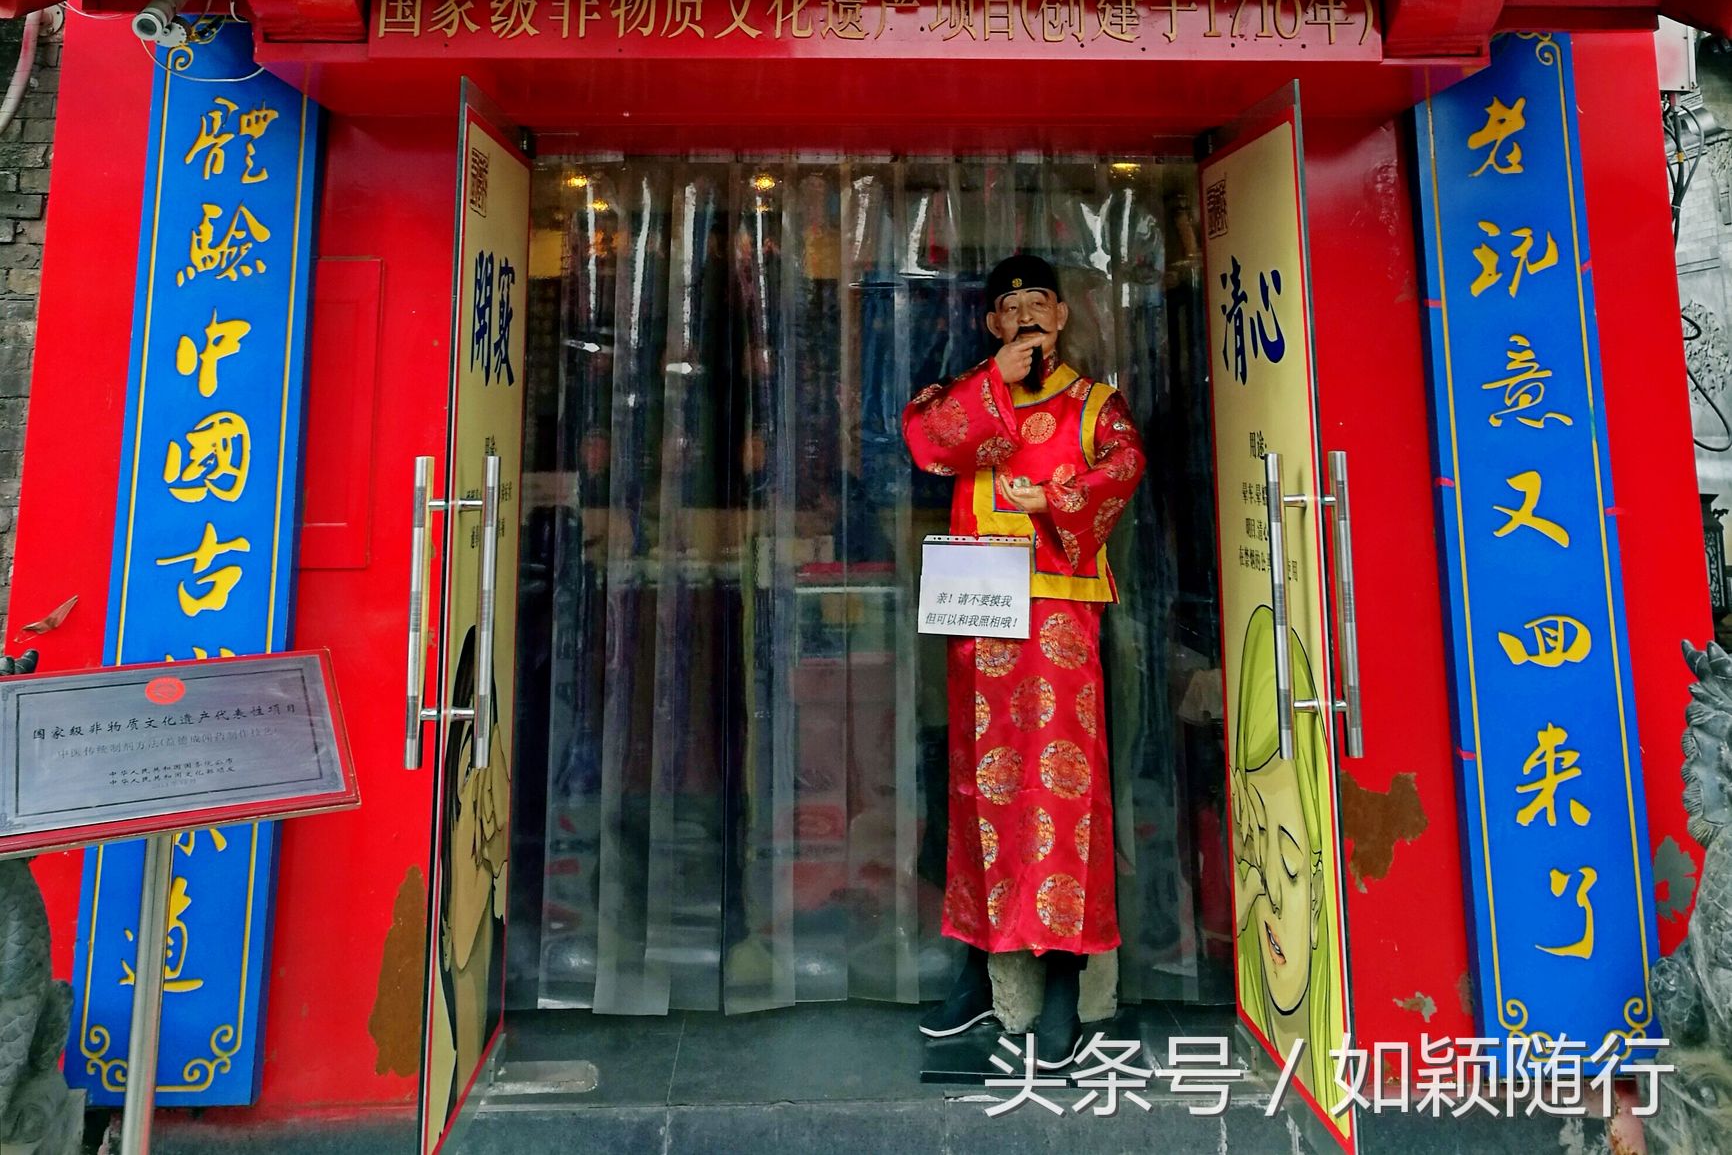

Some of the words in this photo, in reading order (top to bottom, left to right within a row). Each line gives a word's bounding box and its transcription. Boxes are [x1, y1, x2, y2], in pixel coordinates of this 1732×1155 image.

[33, 703, 297, 740] 国家级非物质文化遗产代表性项目
